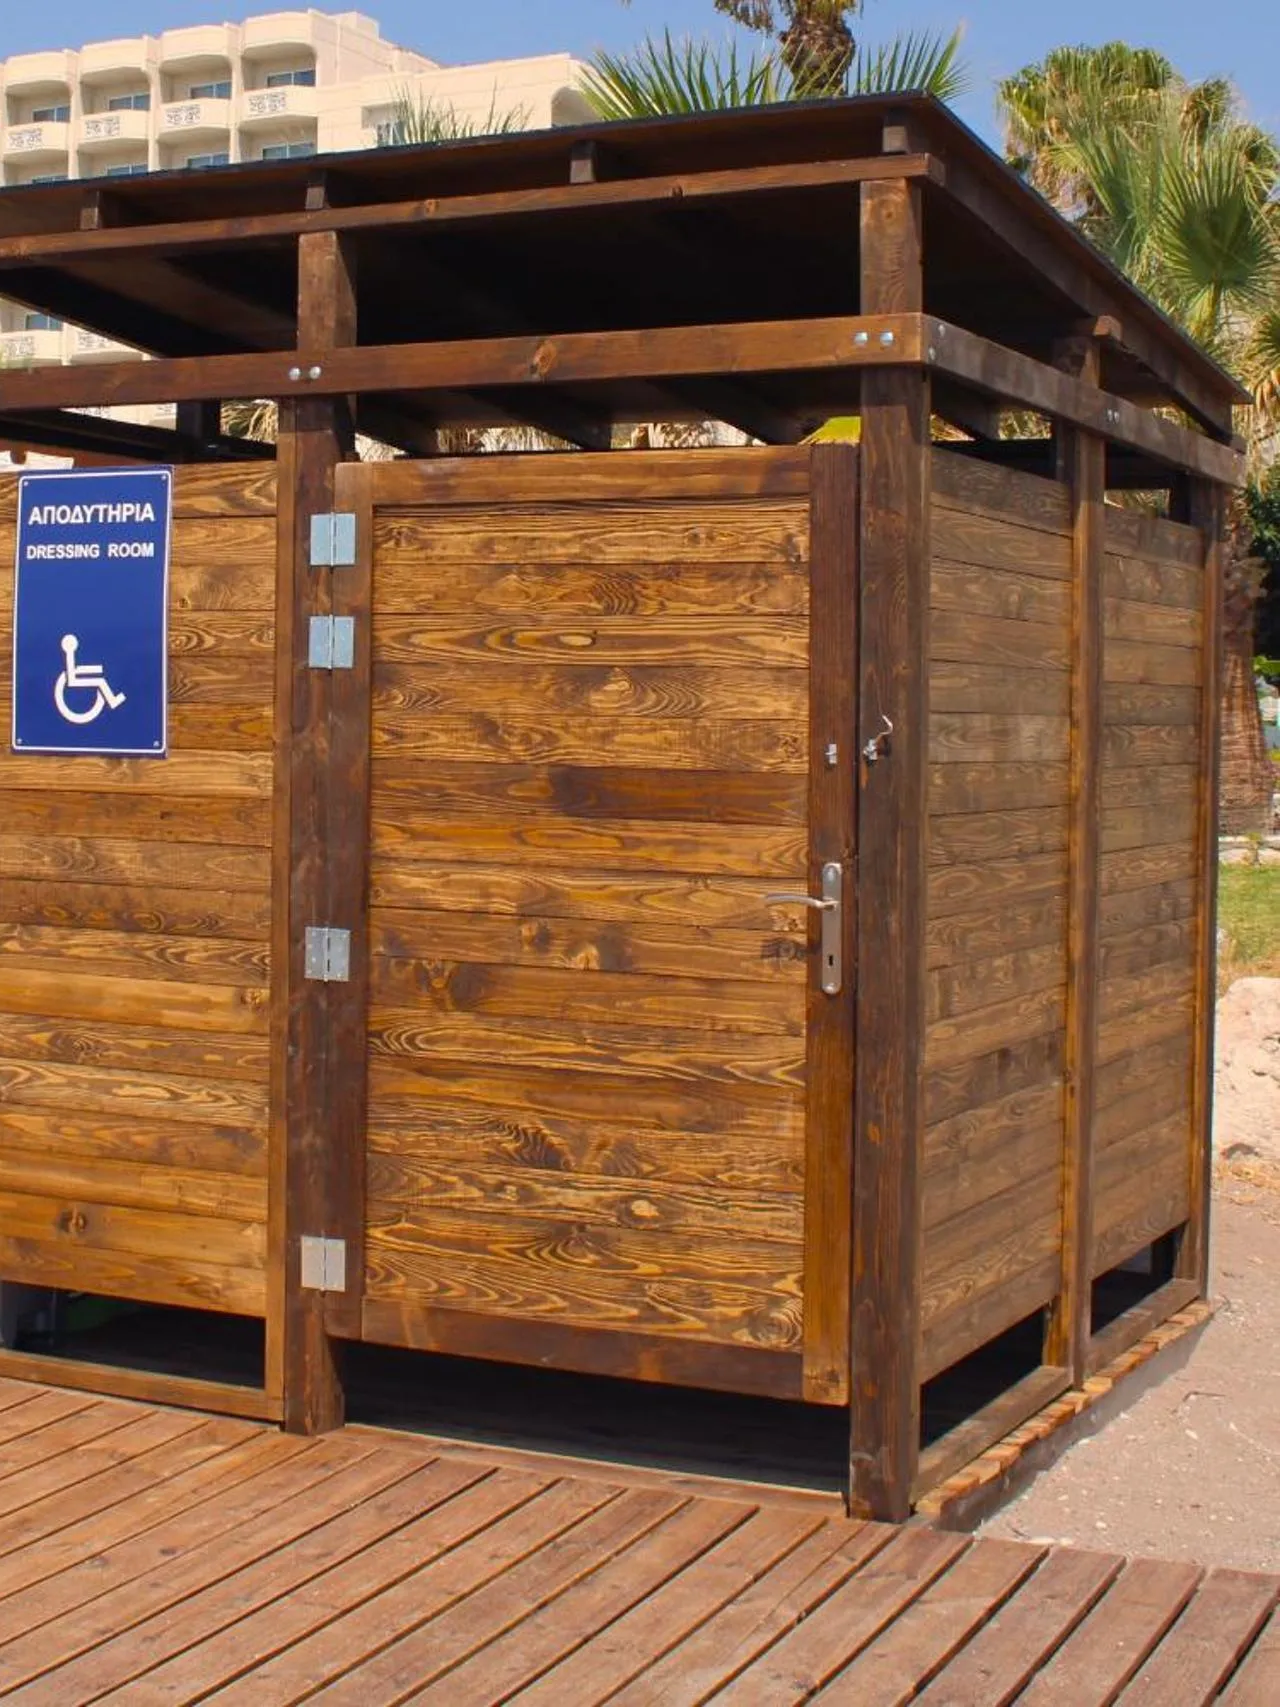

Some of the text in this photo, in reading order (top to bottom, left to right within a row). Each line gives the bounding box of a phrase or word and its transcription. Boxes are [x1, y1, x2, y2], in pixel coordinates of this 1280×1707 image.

[28, 502, 156, 526] ΑΠΟΔΥΤΗΡΙΑ
[26, 541, 155, 559] DRESSING ROOM
